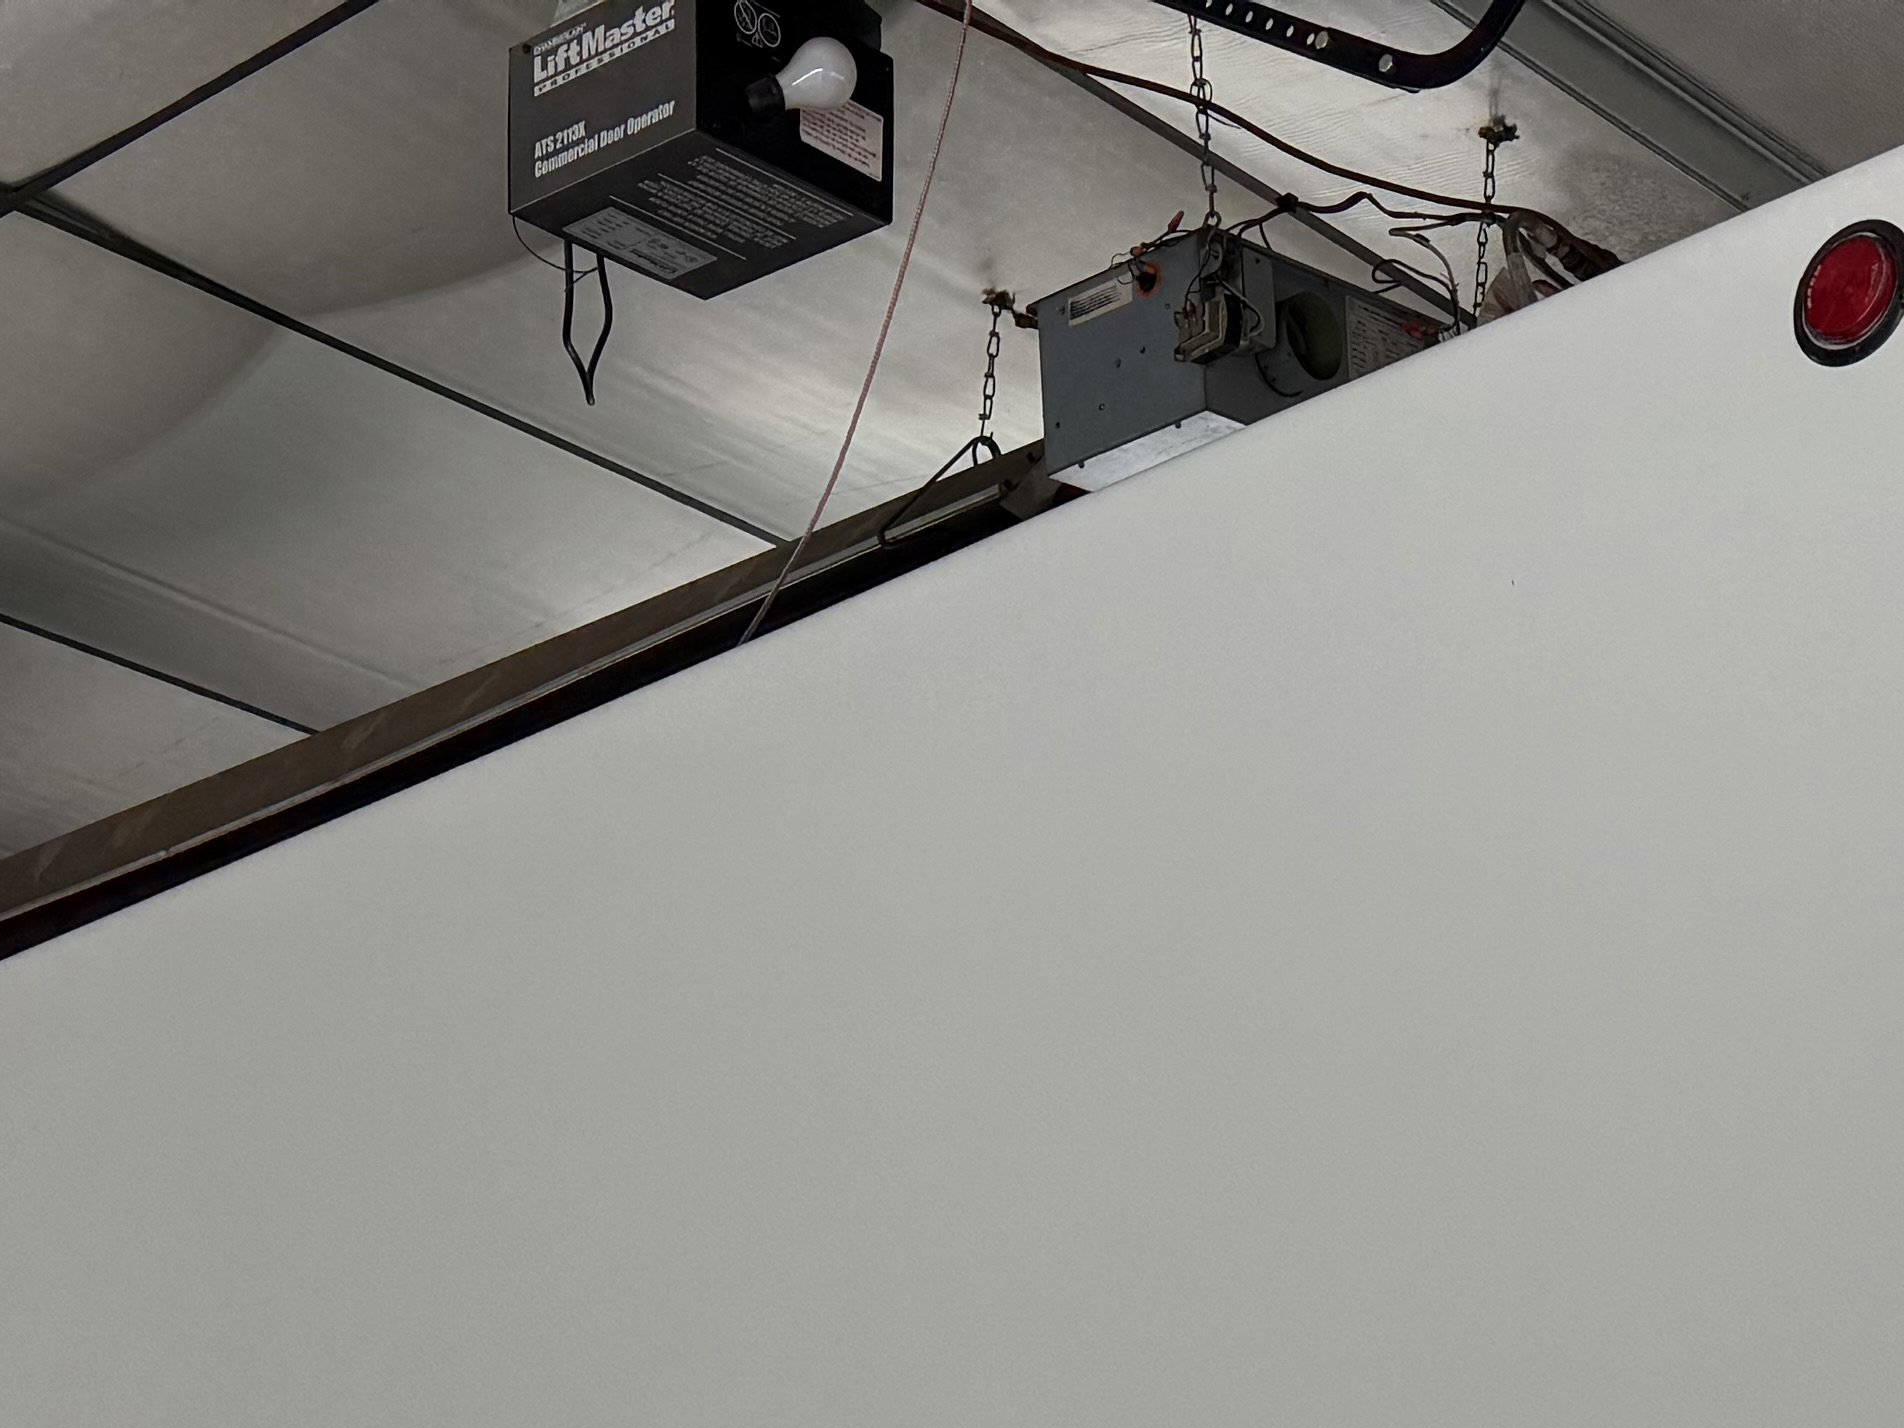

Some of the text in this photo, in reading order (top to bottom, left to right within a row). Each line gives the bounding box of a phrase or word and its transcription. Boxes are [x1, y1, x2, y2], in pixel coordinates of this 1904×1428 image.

[535, 20, 675, 95] PROFESSIONAL
[534, 136, 555, 159] ATS
[535, 100, 676, 178] Commercial Door Operator
